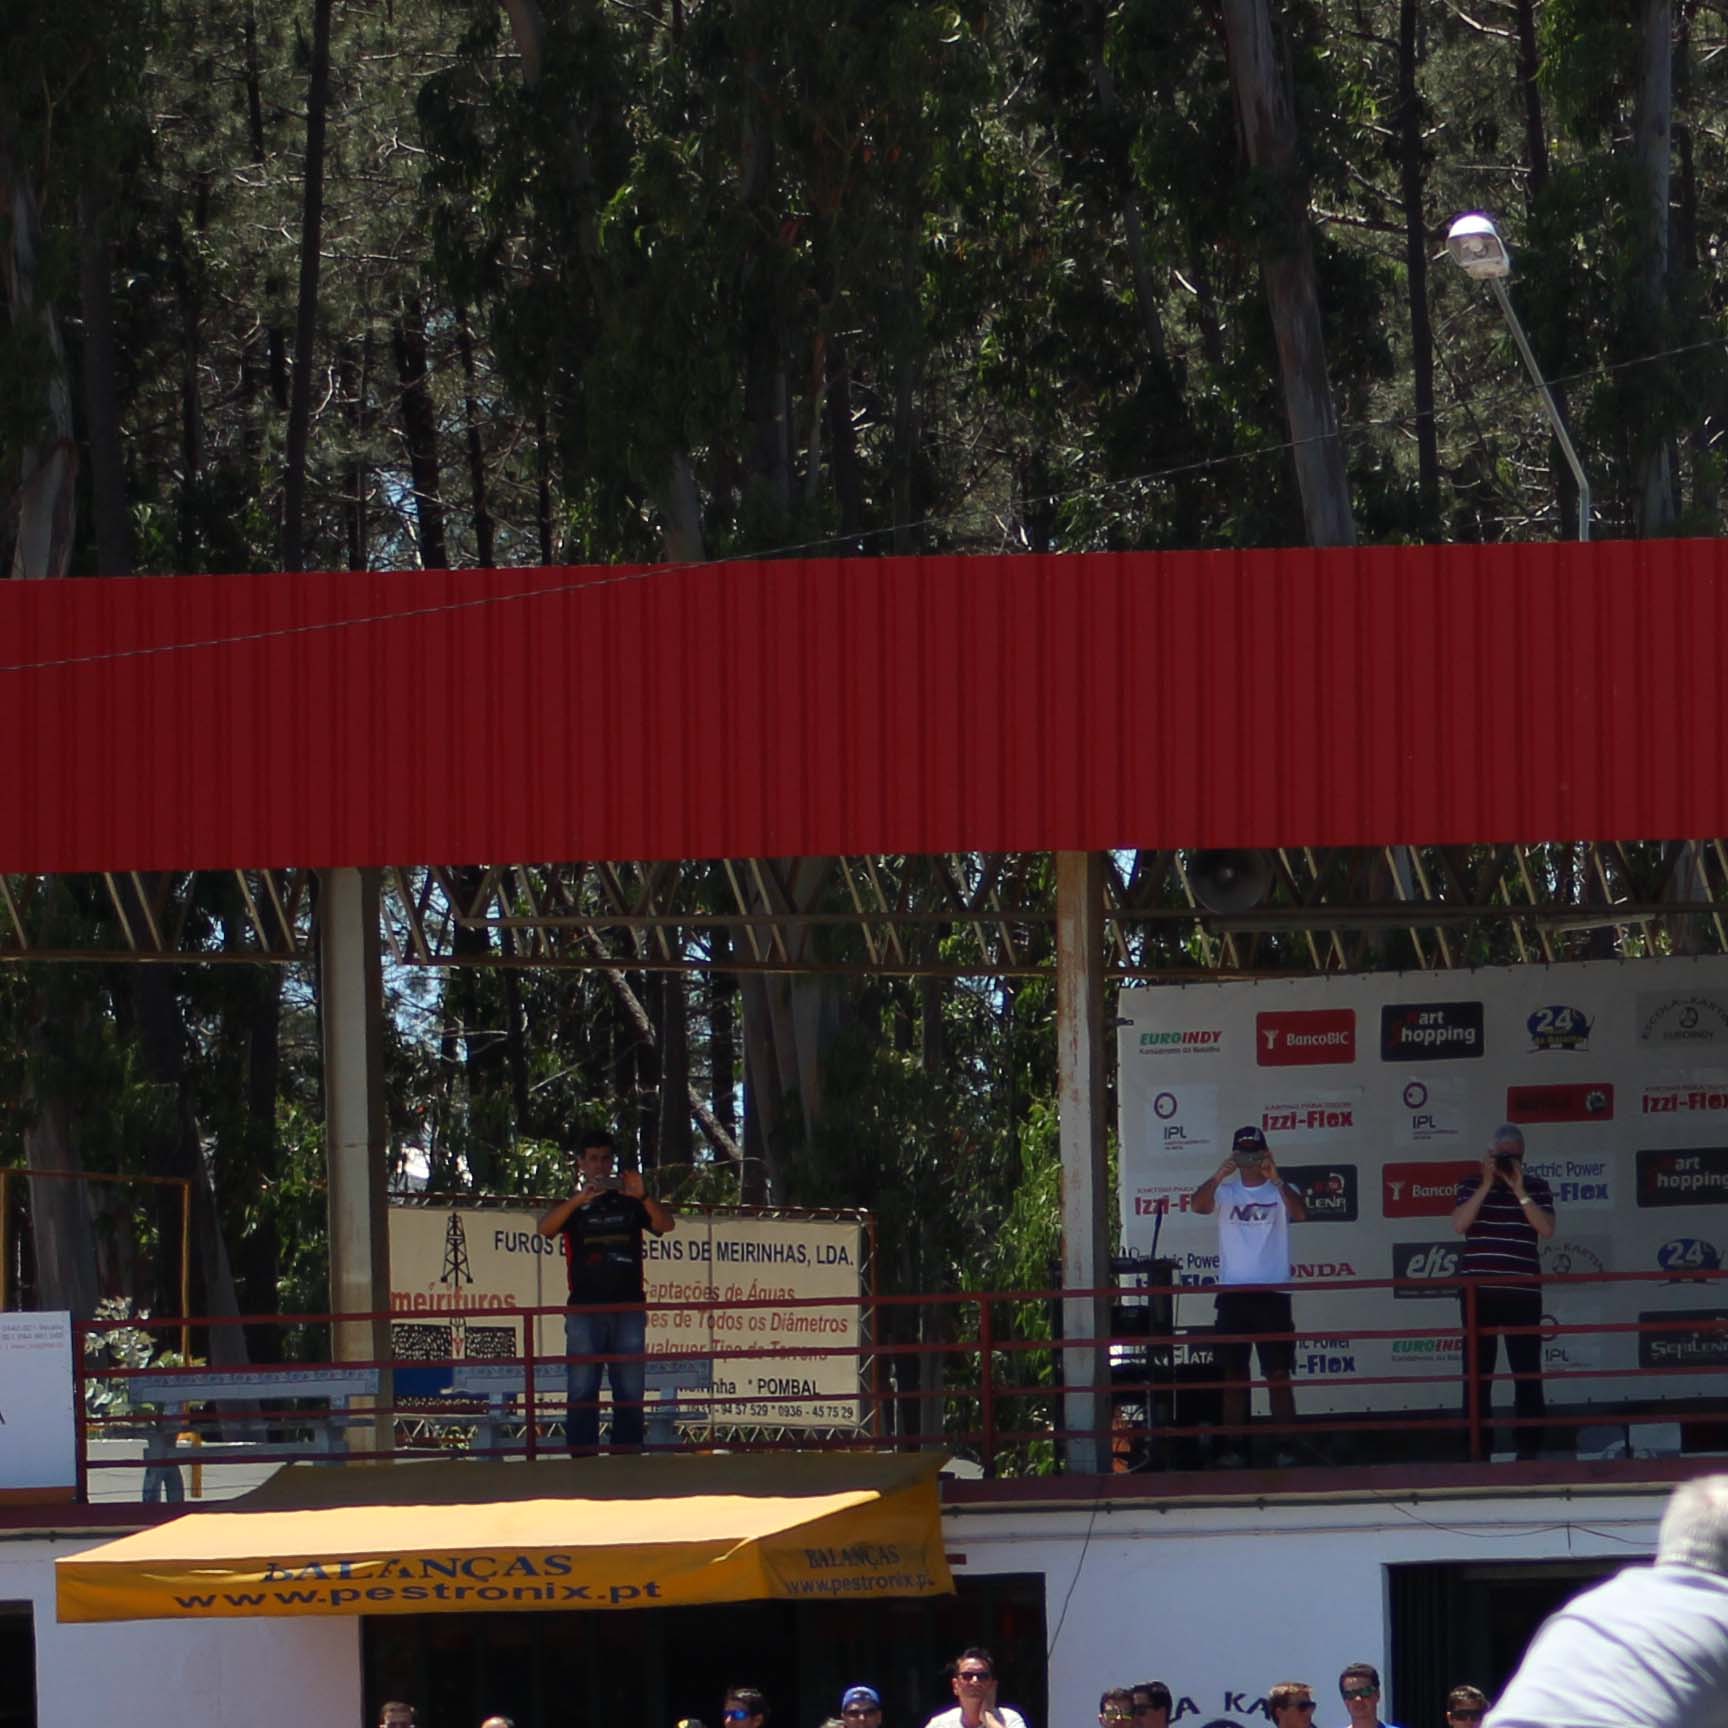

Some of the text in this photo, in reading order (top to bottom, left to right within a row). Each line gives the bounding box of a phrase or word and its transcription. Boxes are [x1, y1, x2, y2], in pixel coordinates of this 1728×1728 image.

[1535, 1009, 1574, 1032] 24
[1140, 1031, 1222, 1046] EUROINDY
[1286, 1031, 1349, 1047] BancoBIC
[1412, 1115, 1438, 1129] IPL
[1164, 1125, 1188, 1140] IPL
[1523, 1160, 1606, 1178] lectric Power
[494, 1230, 554, 1255] FUROS
[689, 1241, 712, 1262] DE
[716, 1241, 811, 1267] MEIRINHAS,
[816, 1245, 854, 1266] LDA.
[1666, 1241, 1703, 1266] 24
[1187, 1253, 1220, 1269] Powe
[725, 1283, 743, 1301] de
[673, 1310, 692, 1328] de
[698, 1311, 743, 1332] Todos
[748, 1317, 767, 1332] os
[770, 1311, 848, 1334] Diâmetros
[756, 1378, 820, 1397] POMBAL
[264, 1553, 573, 1584] BALANÇAS
[174, 1580, 663, 1609] www.pestronix.pt
